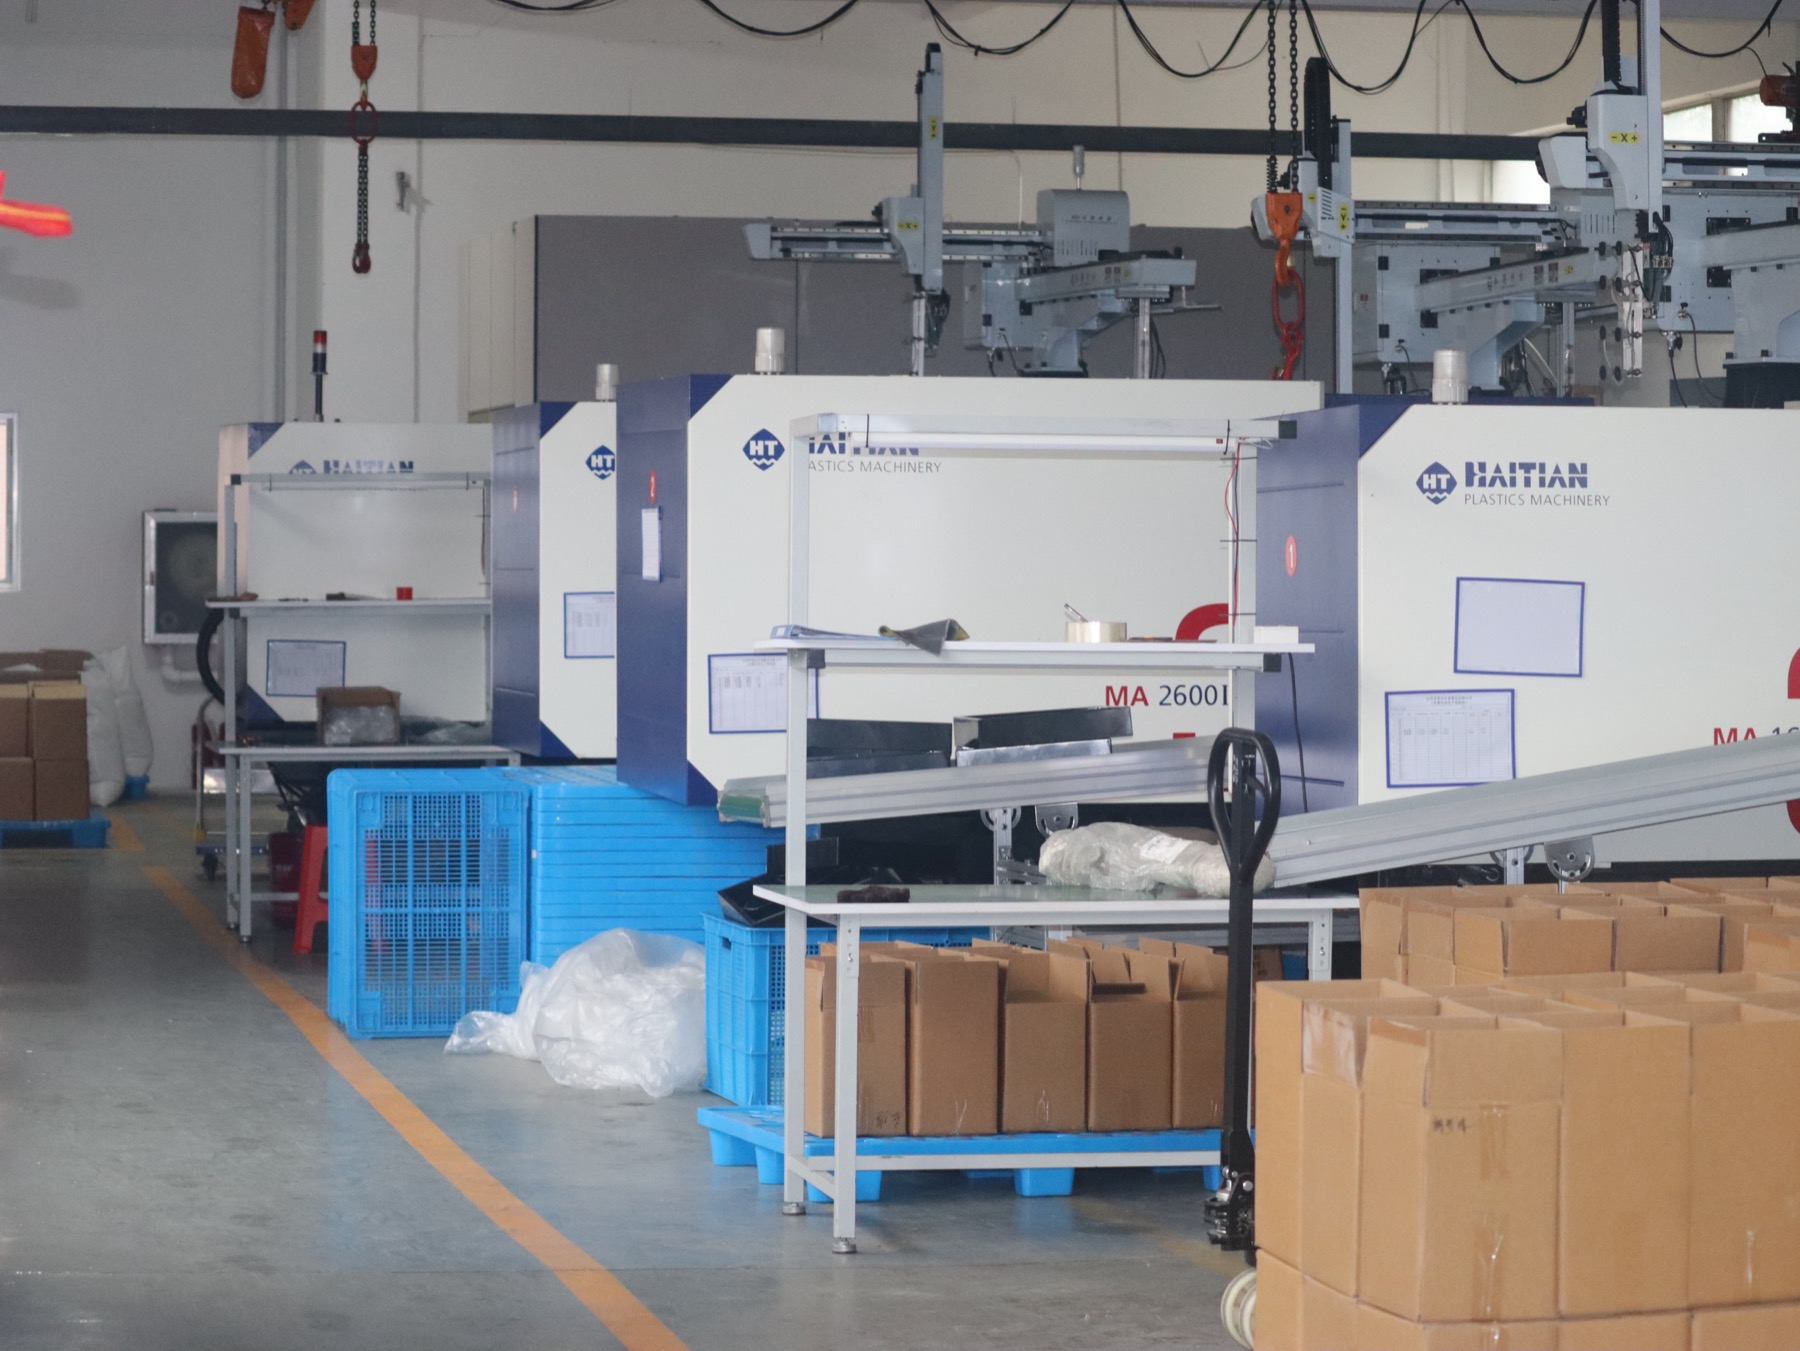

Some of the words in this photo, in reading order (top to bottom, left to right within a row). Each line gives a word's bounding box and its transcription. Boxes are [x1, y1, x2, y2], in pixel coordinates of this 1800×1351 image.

[750, 440, 779, 456] HT
[591, 454, 615, 468] HT
[808, 460, 854, 473] ASTICS
[860, 460, 942, 474] MACHINERY
[1422, 473, 1451, 490] HT
[1465, 461, 1588, 488] HAITIAN
[1464, 493, 1525, 506] PLASTICS
[1530, 494, 1611, 507] MACHINERY
[1105, 685, 1149, 707] MA
[1713, 727, 1757, 746] MA
